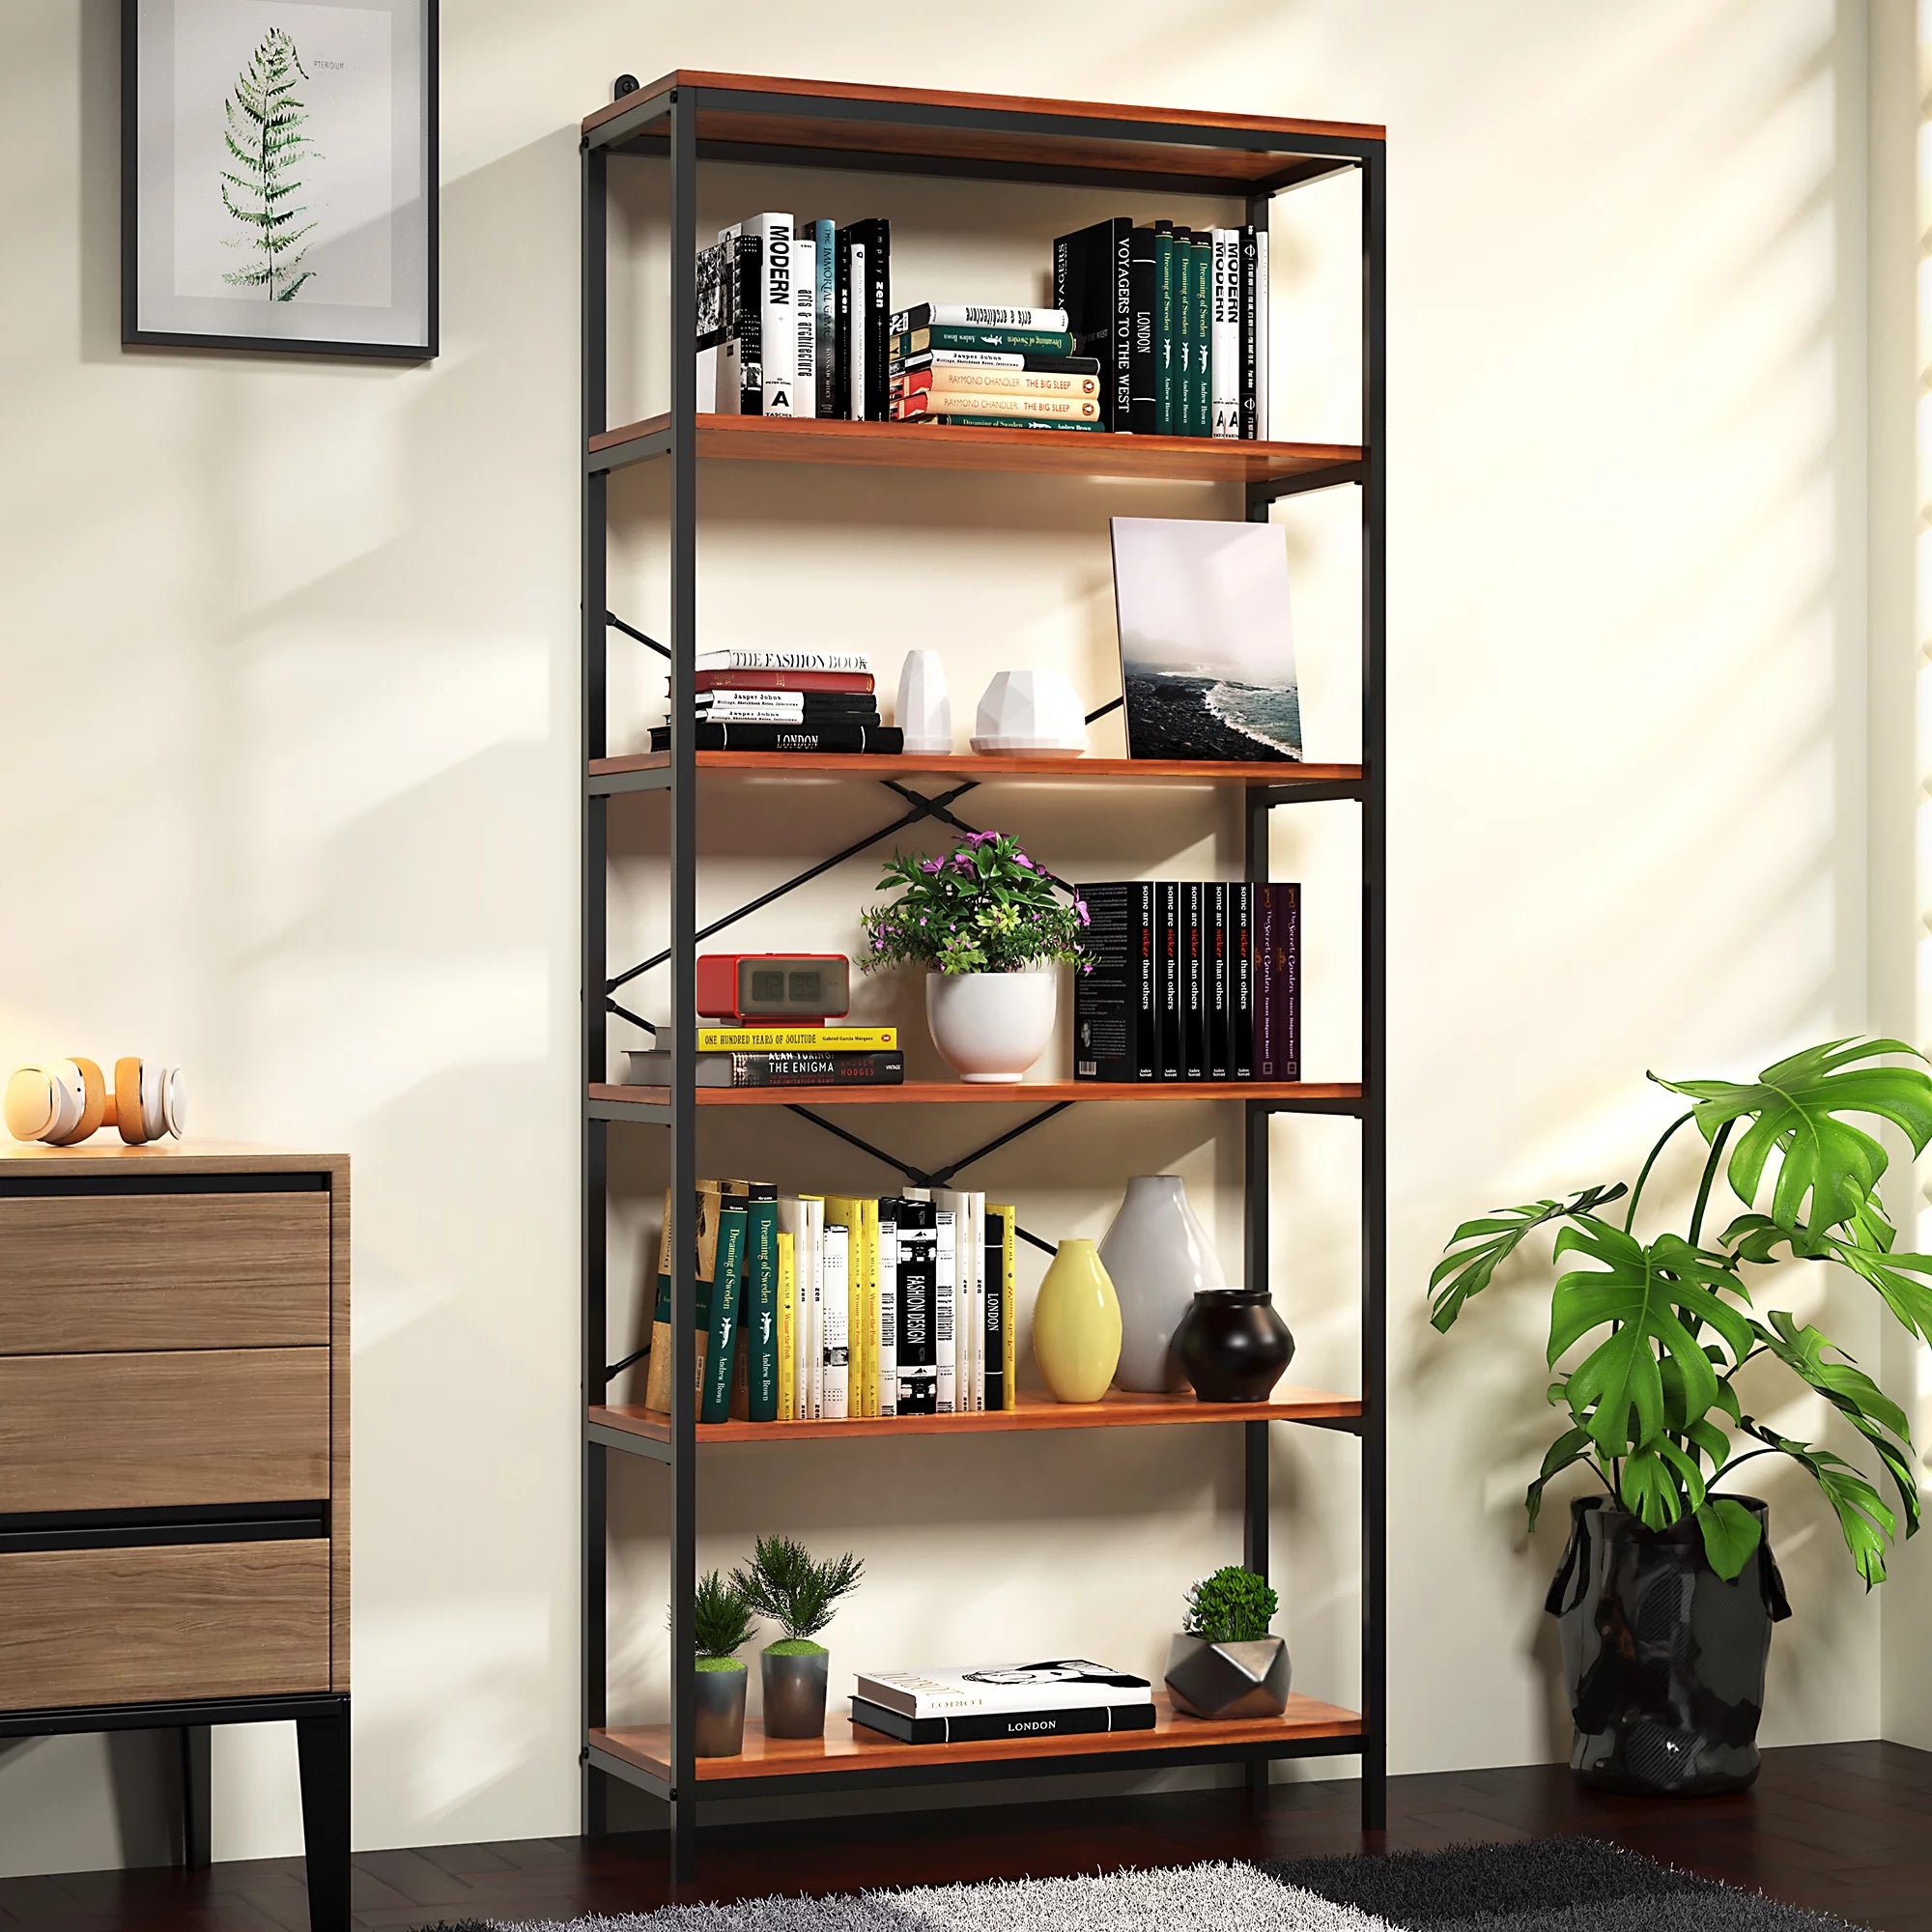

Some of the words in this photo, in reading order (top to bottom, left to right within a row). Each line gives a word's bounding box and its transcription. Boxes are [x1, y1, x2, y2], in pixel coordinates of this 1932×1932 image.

[770, 226, 789, 304] MODERN
[821, 247, 832, 301] IMMORTAL
[1118, 238, 1129, 314] VOYAGERS
[1161, 253, 1171, 290] Dreaming
[1179, 258, 1188, 295] Dreaming
[1197, 263, 1208, 298] Dreaming
[1215, 242, 1224, 322] MODERN
[1228, 242, 1237, 323] MODERN
[798, 290, 813, 307] arts
[1164, 291, 1171, 300] of
[1182, 296, 1189, 305] of
[1200, 299, 1208, 308] of
[823, 305, 832, 338] GAME
[1119, 317, 1129, 337] TO
[1137, 311, 1151, 354] LONDON
[798, 323, 814, 377] architecture
[1008, 335, 1029, 347] Sweden
[1036, 335, 1062, 348] Dreaming
[1119, 340, 1129, 369] THE
[949, 375, 982, 385] RAYMOND
[984, 377, 1020, 386] CHANDLER
[1026, 379, 1038, 388] THE
[1040, 380, 1051, 389] BIG
[1053, 381, 1070, 389] SLEEP
[771, 390, 789, 407] A
[1119, 374, 1129, 413] WEST
[945, 398, 979, 408] RAYMOND
[980, 400, 1018, 410] CHANDLER
[1024, 402, 1037, 411] THE
[1038, 403, 1050, 412] BIG
[1216, 411, 1225, 427] A
[1229, 411, 1238, 427] A
[733, 653, 762, 667] THE
[765, 653, 825, 668] FASHION
[829, 655, 867, 669] BOOK
[777, 734, 818, 749] LONDON
[705, 1035, 718, 1044] ONE
[721, 1035, 750, 1044] HUNDRED
[752, 1035, 773, 1044] YEARS
[775, 1035, 783, 1044] OF
[785, 1034, 816, 1044] SOLITUDE
[768, 1052, 793, 1061] ALAN
[769, 1062, 788, 1073] THE
[792, 1062, 835, 1073] ENIGMA
[840, 1067, 874, 1076] HODGES
[724, 1229, 740, 1267] Dreaming
[757, 1220, 771, 1260] Dreaming
[725, 1268, 735, 1278] of
[761, 1262, 771, 1271] of
[723, 1278, 736, 1310] Sweden
[761, 1271, 771, 1304] Sweden
[907, 1275, 925, 1312] FASHION
[987, 1293, 999, 1331] LONDON
[907, 1314, 925, 1344] DESIGN
[718, 1356, 727, 1380] Andrew
[716, 1382, 725, 1404] Brown
[1008, 1720, 1056, 1732] LONDON
